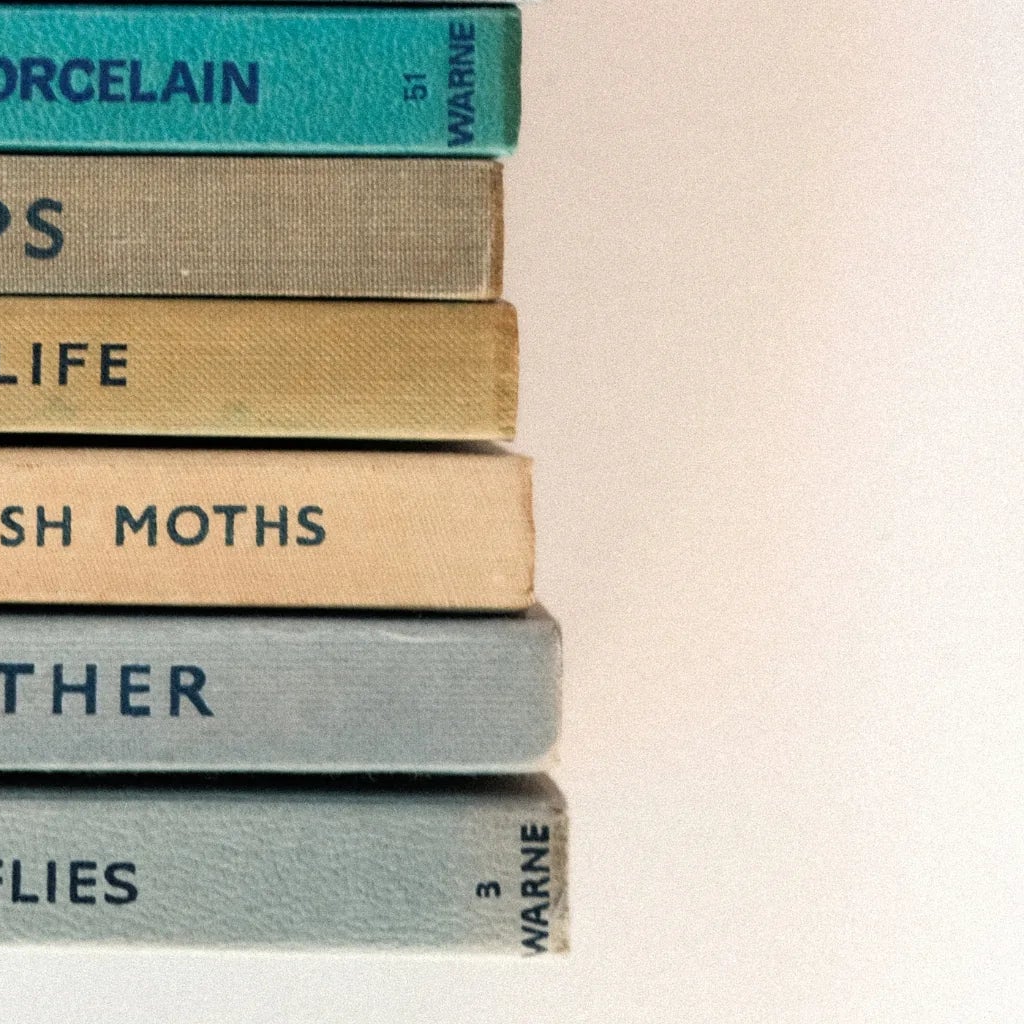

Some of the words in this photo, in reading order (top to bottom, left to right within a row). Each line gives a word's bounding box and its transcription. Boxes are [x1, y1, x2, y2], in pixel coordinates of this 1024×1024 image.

[402, 70, 428, 105] 51
[448, 21, 475, 148] WARNE
[116, 502, 326, 547] MOTHS
[476, 880, 502, 898] 3
[520, 824, 551, 958] WARNE
